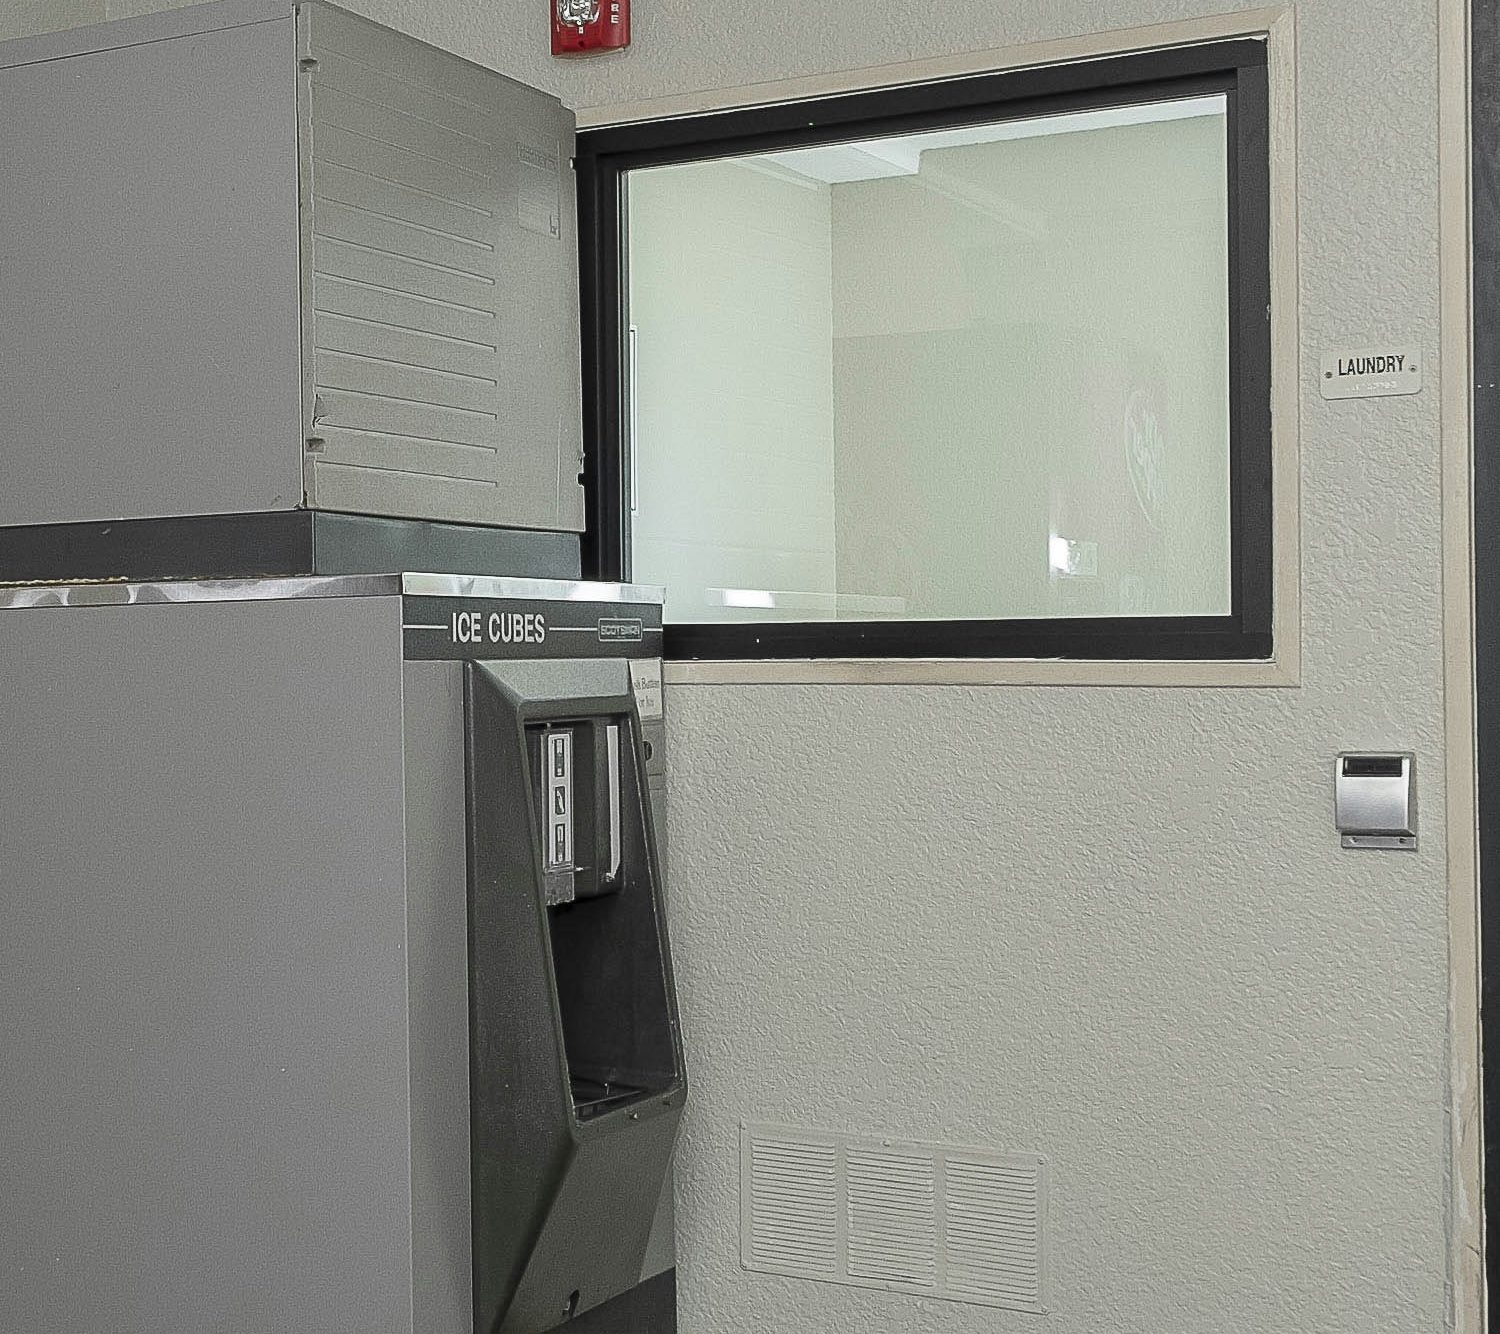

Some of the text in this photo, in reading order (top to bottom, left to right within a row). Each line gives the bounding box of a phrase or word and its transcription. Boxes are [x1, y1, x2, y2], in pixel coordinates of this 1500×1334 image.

[1338, 355, 1405, 376] LAUNDRY
[452, 612, 482, 643] ICE
[488, 613, 545, 644] CUBES
